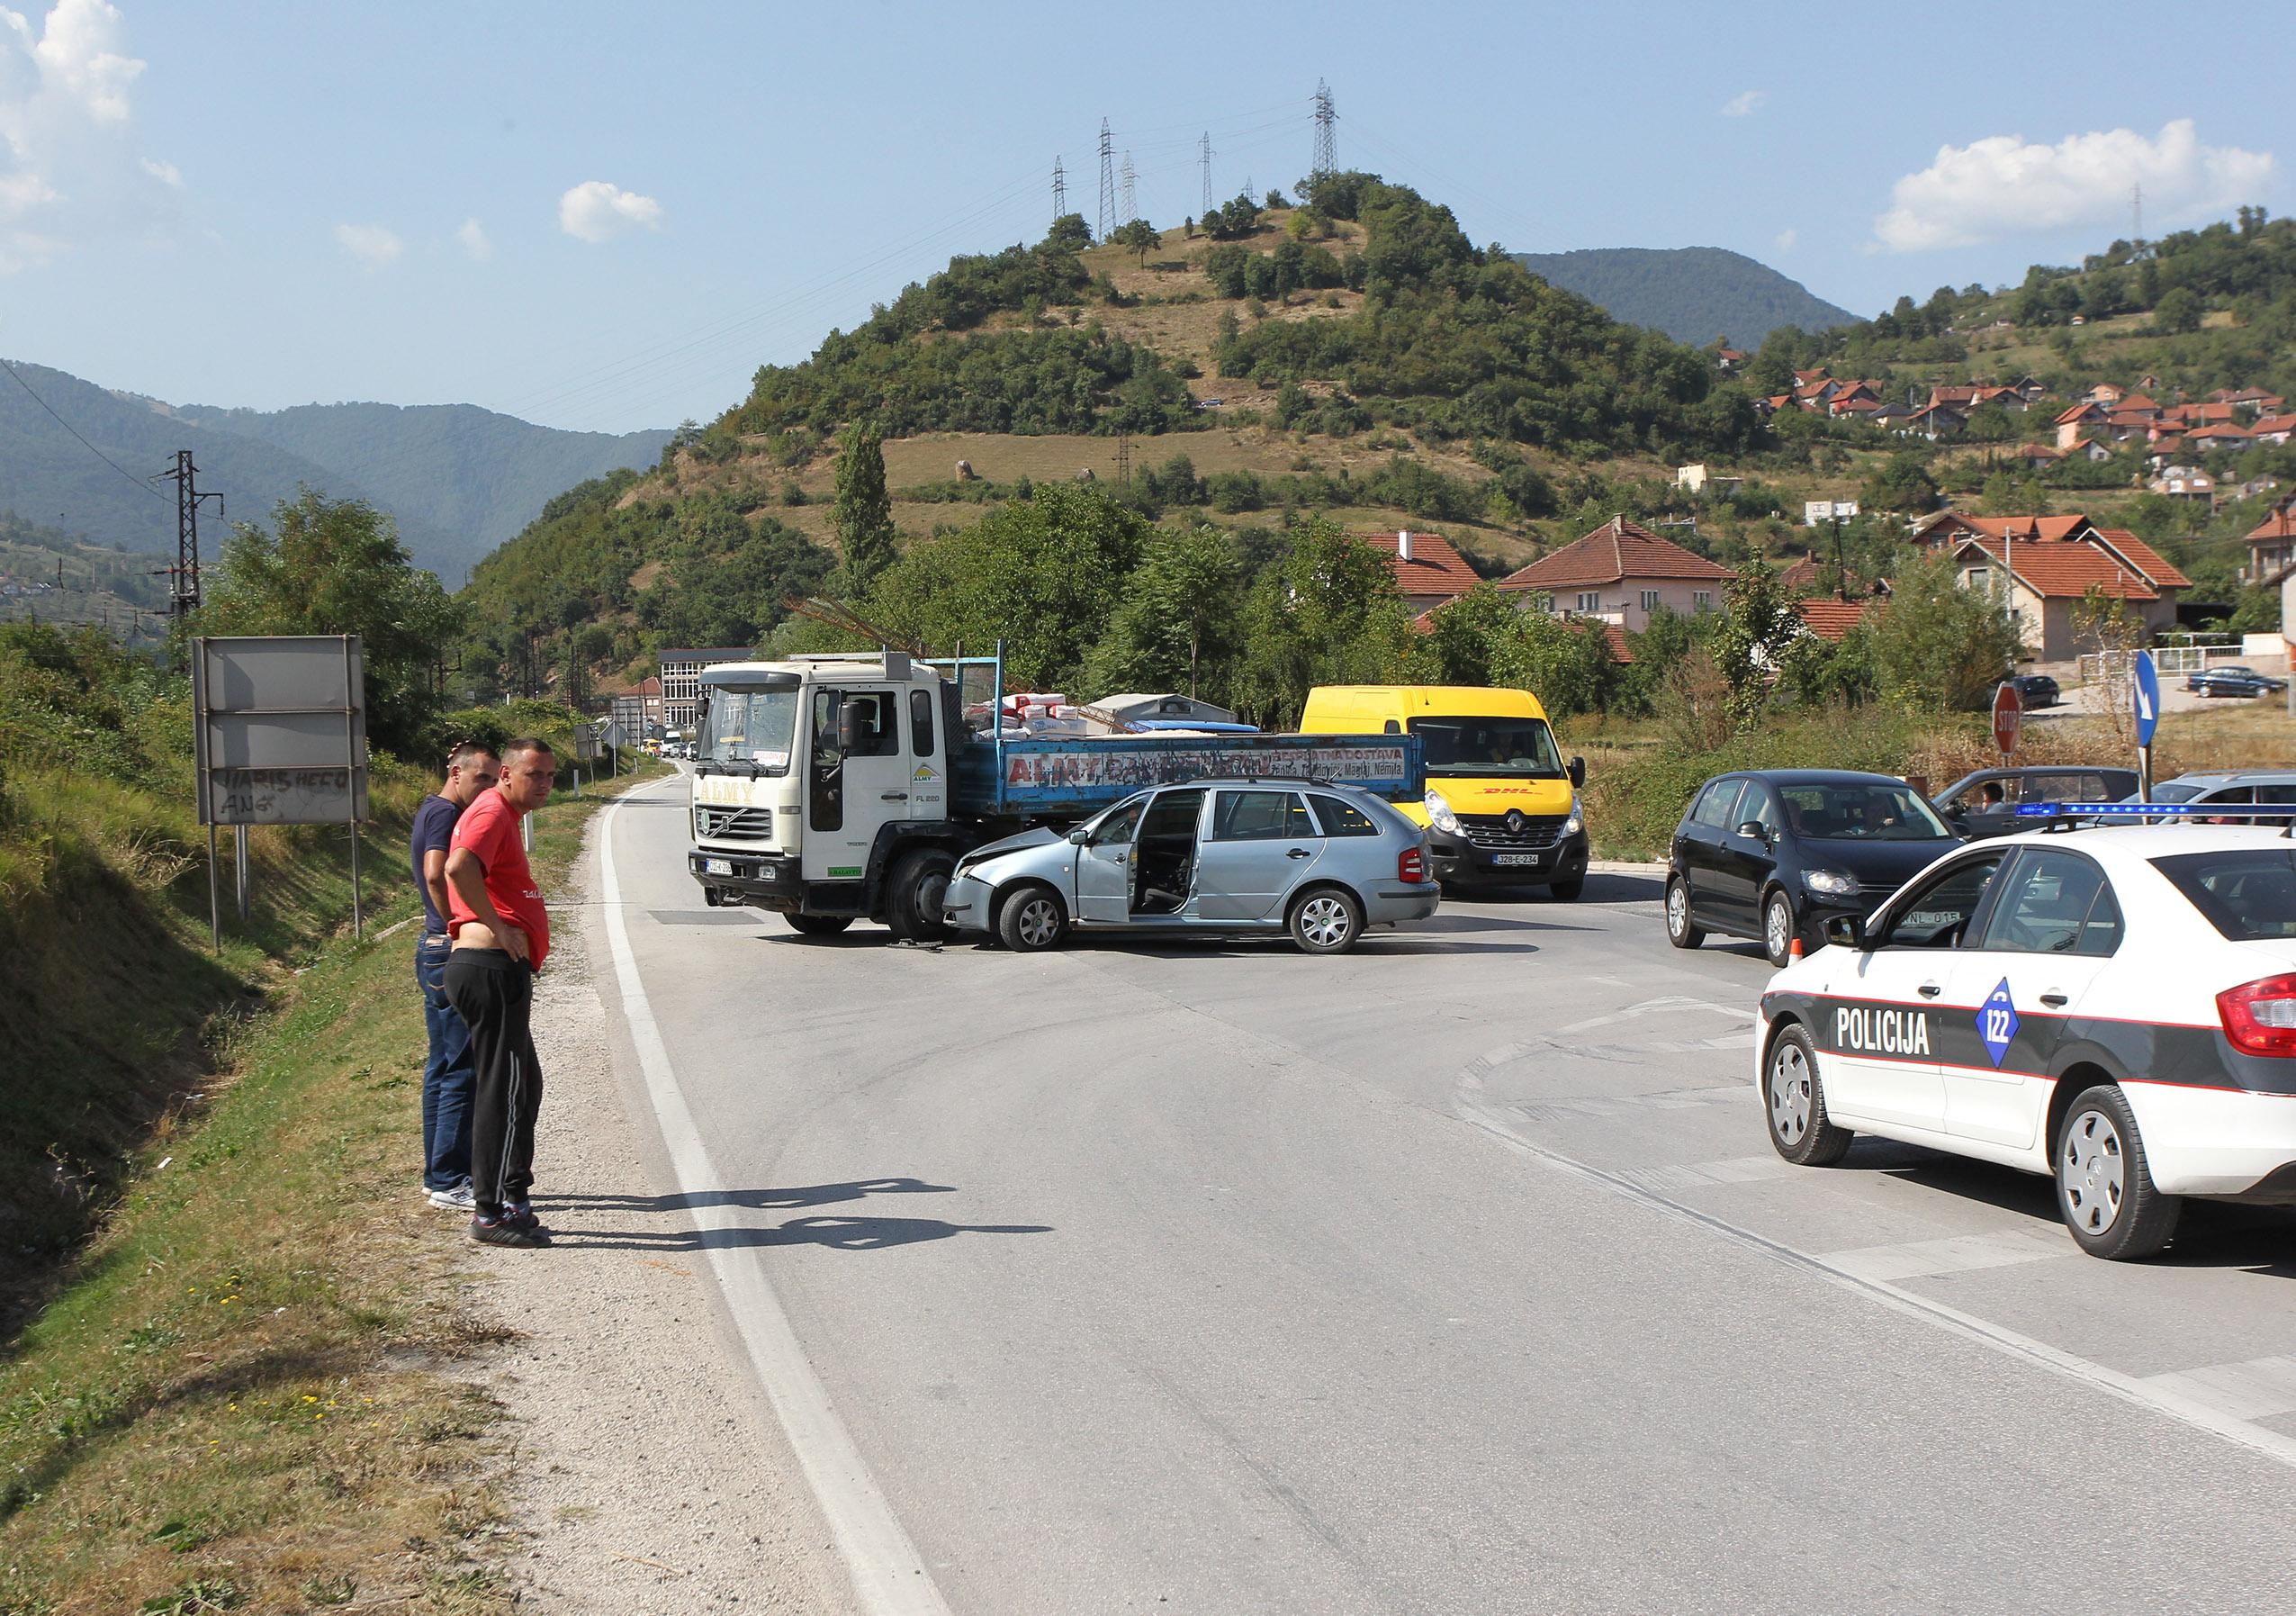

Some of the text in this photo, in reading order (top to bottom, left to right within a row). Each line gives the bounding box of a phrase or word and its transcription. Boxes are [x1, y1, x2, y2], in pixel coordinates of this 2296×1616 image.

[1998, 710, 2017, 732] STOP
[1345, 748, 1402, 761] DOSTAVA
[700, 780, 754, 807] ALMY
[1837, 1007, 1931, 1055] POLICIJA
[1986, 1008, 2010, 1044] 122
